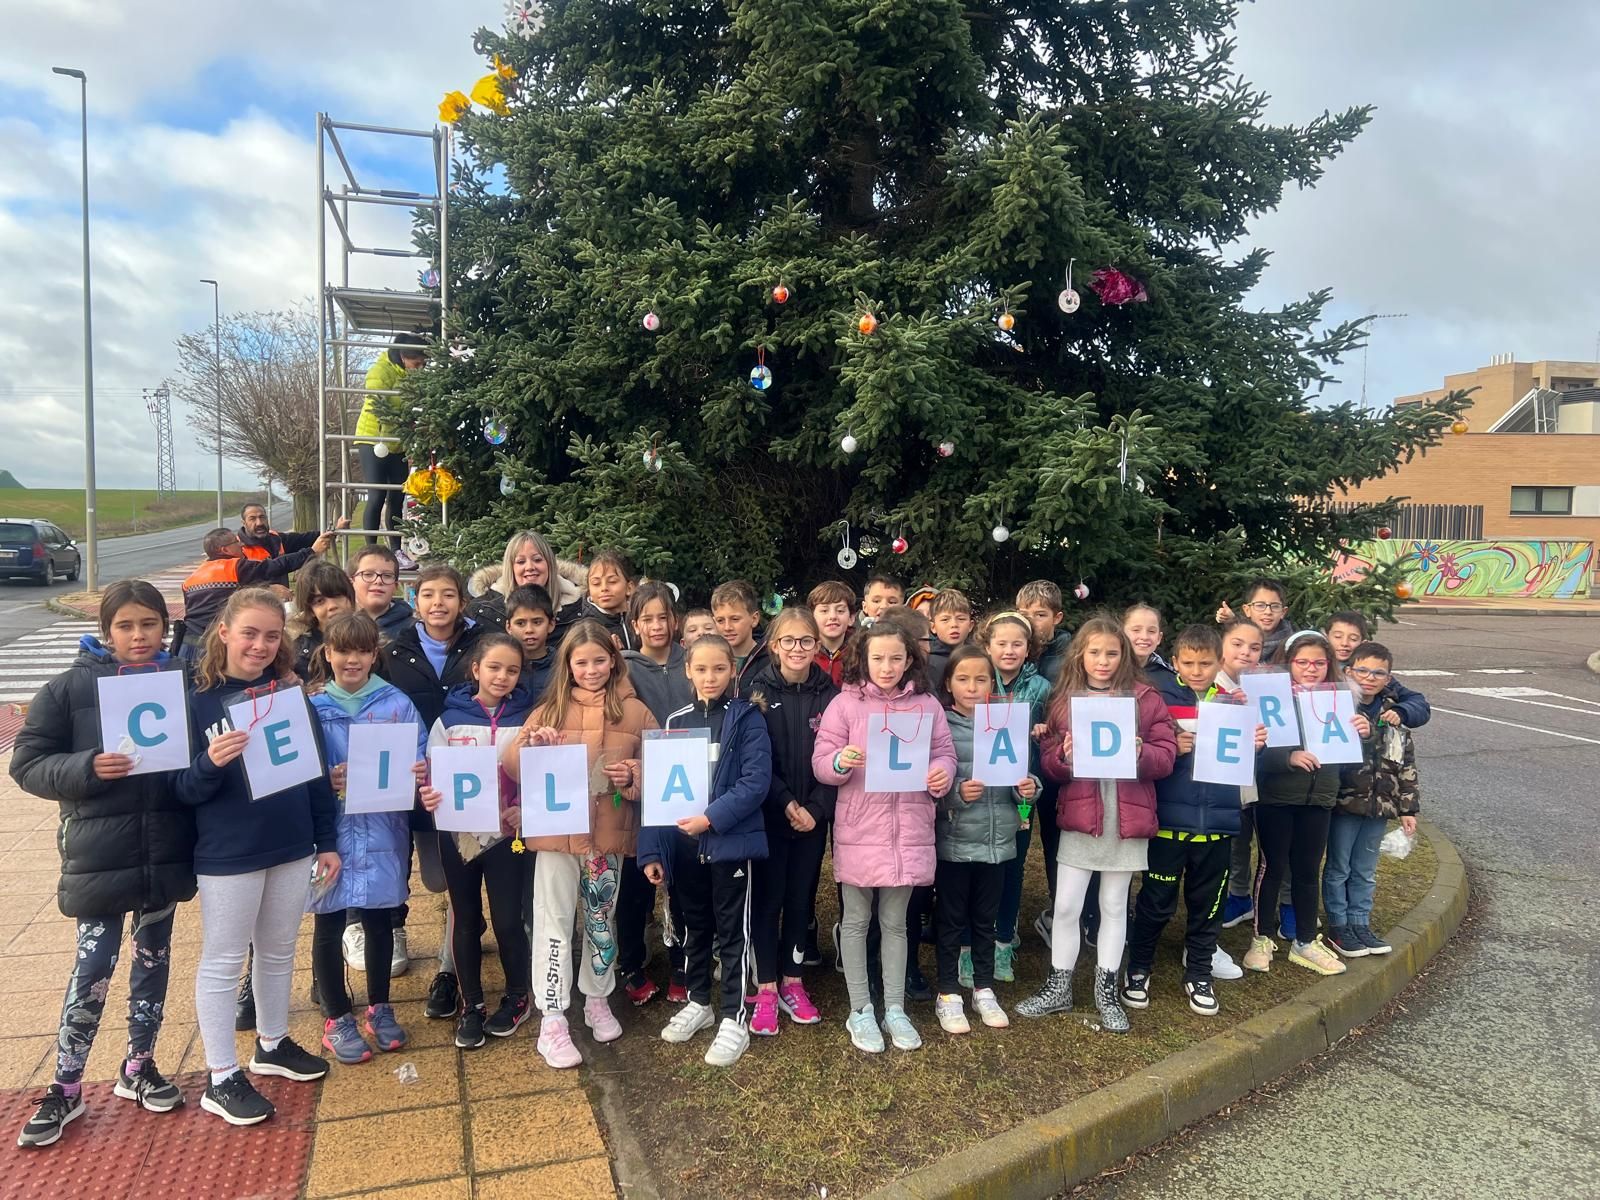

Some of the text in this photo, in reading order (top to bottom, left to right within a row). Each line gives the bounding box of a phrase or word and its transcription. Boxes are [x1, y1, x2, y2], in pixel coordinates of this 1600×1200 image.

[128, 702, 167, 748] C
[1260, 696, 1285, 726] R
[1322, 711, 1348, 744] A
[264, 719, 299, 766] E
[889, 737, 912, 771] L
[989, 727, 1018, 764] A
[1092, 721, 1121, 757] D
[1217, 728, 1242, 764] E
[378, 750, 390, 789] I
[661, 764, 694, 802] A
[453, 772, 481, 811] P
[545, 773, 571, 812] L
[1149, 872, 1177, 882] KELME
